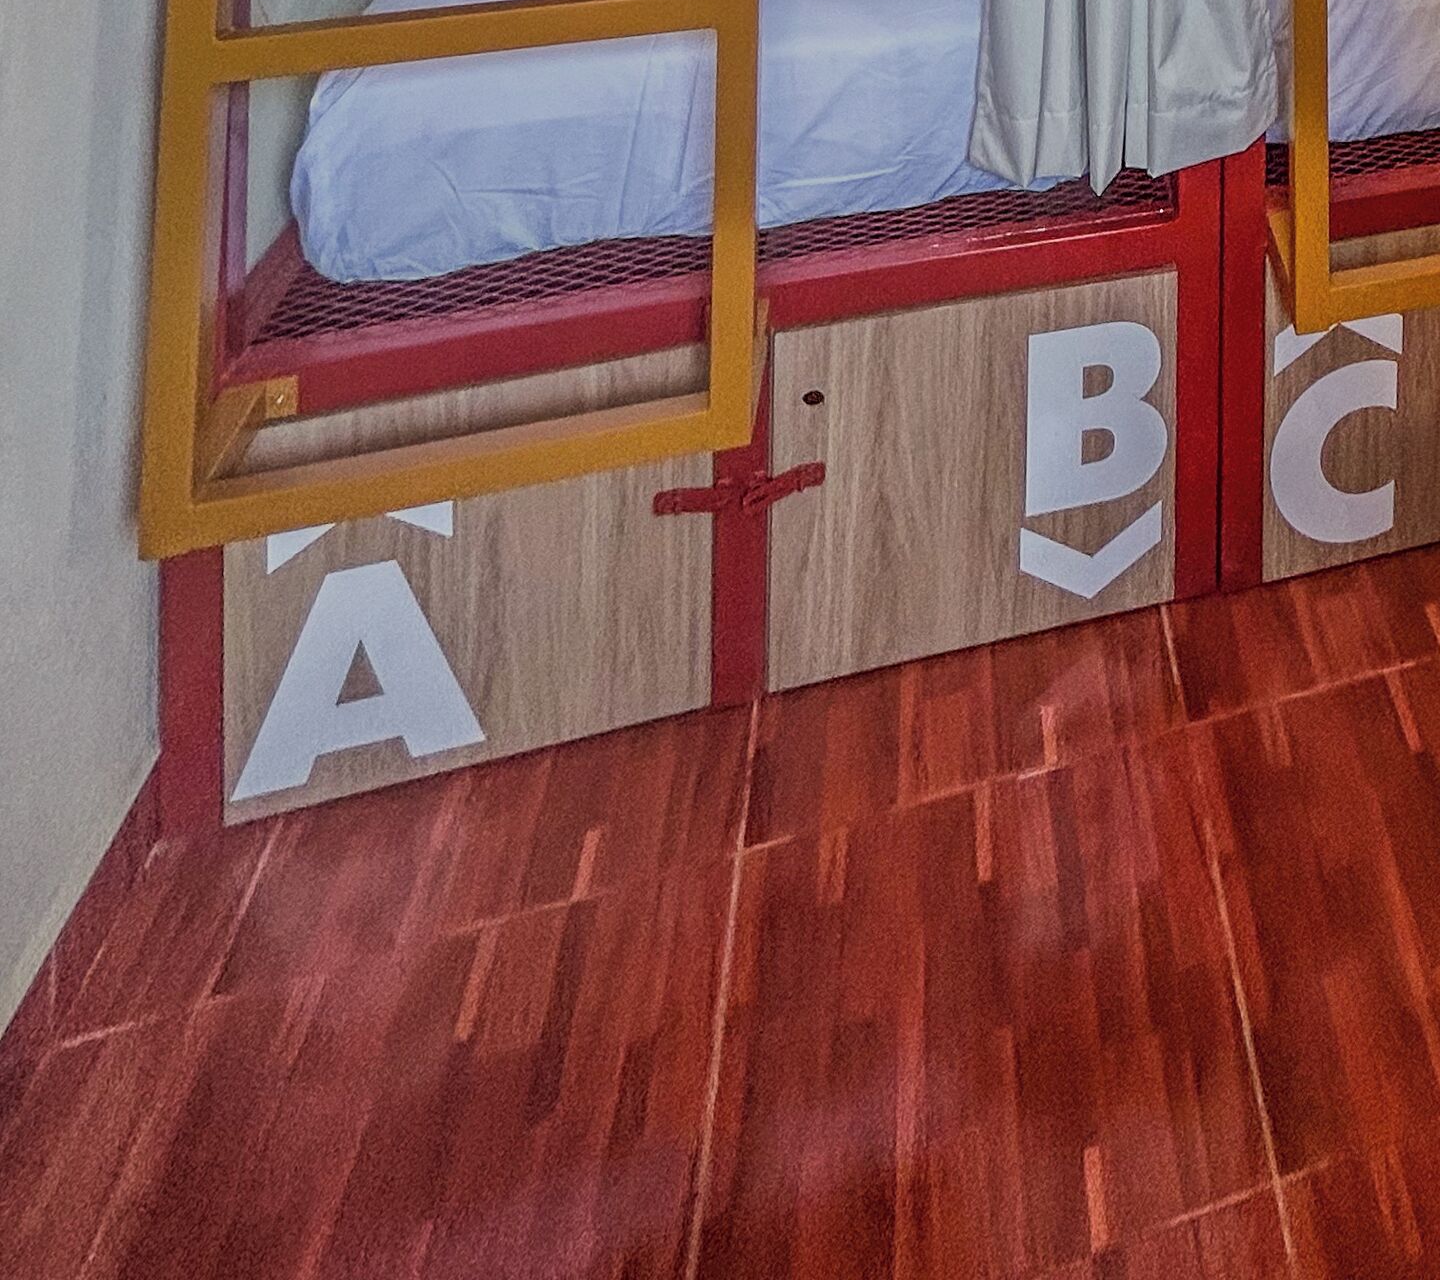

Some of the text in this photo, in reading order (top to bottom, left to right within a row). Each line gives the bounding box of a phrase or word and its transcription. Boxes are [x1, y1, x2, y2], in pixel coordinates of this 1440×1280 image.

[1024, 320, 1169, 517] B
[1268, 358, 1398, 544] C
[230, 559, 487, 803] A
